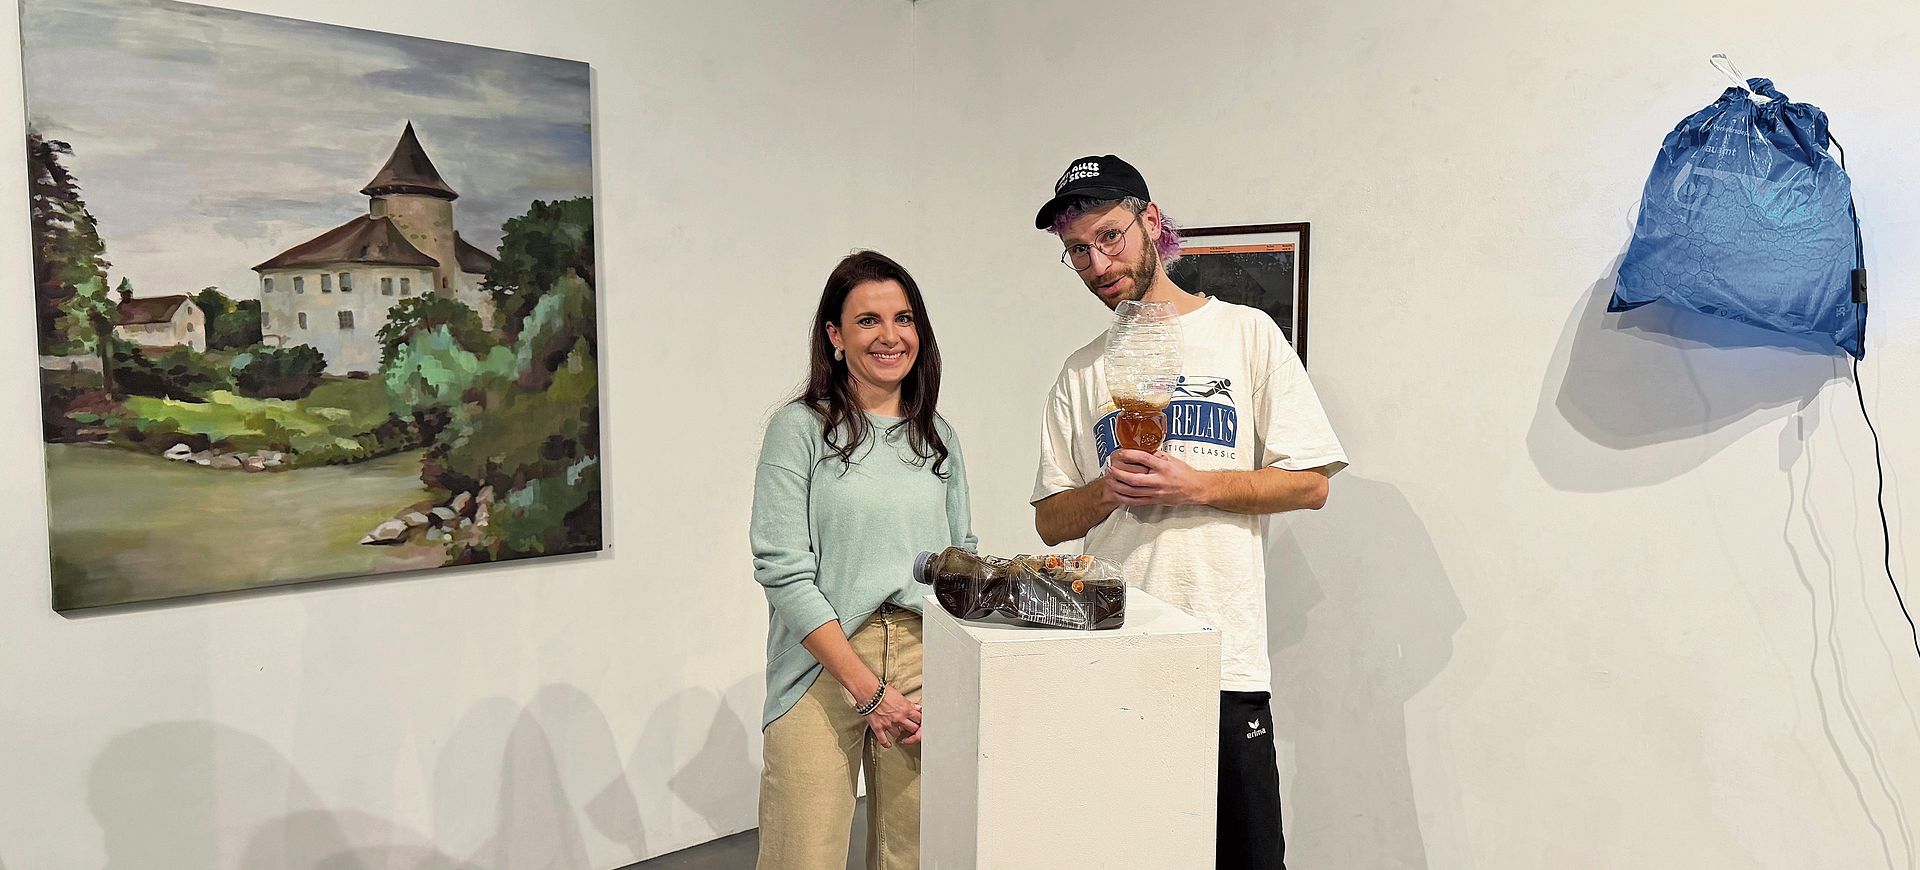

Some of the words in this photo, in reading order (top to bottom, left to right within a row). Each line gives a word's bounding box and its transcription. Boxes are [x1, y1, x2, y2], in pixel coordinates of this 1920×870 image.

[1071, 162, 1100, 173] ALLES
[1171, 404, 1235, 443] RELAYS
[1193, 446, 1236, 460] CLASSIC
